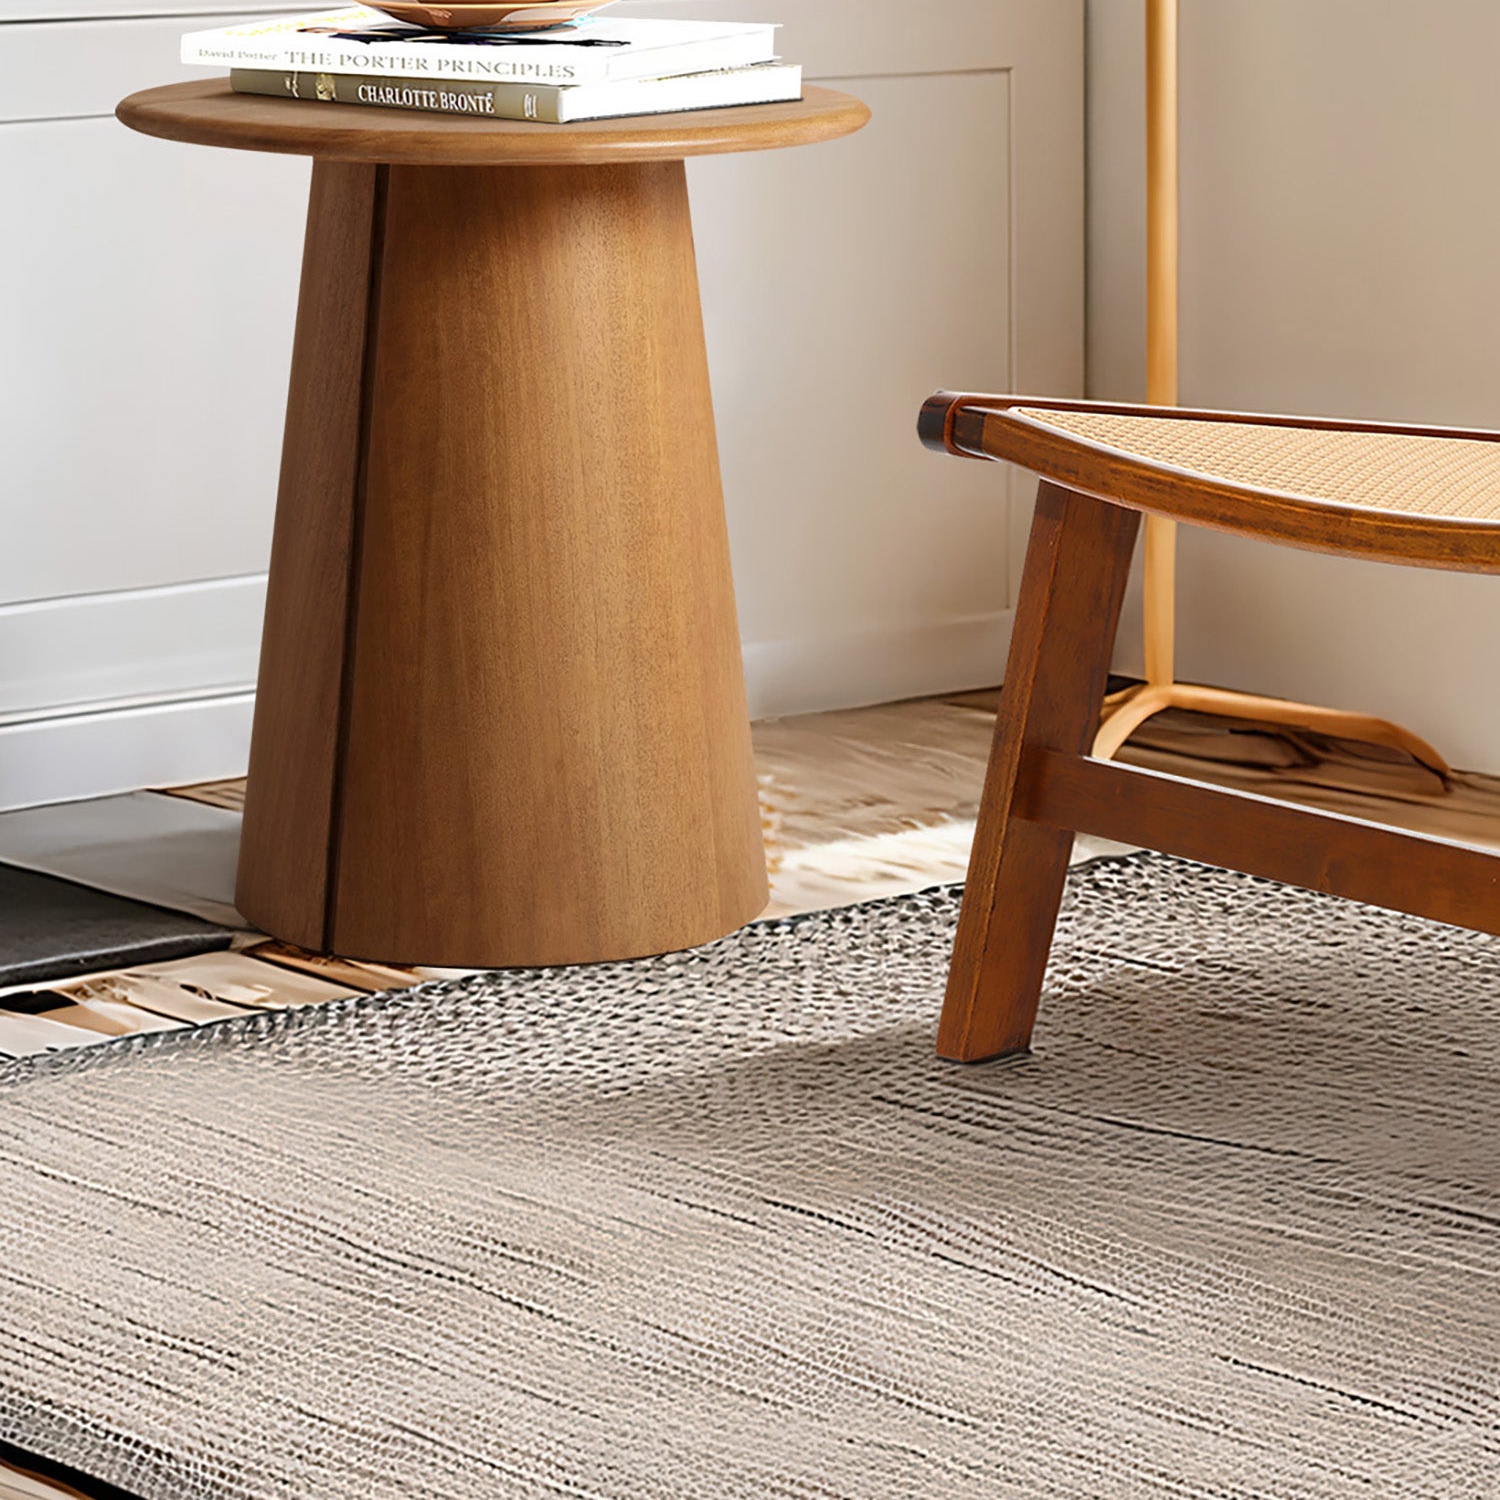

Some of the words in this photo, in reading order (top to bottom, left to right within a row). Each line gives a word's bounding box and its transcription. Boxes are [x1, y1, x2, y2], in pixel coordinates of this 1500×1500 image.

[198, 48, 235, 59] David
[285, 50, 332, 67] THE
[339, 53, 428, 71] PORTER
[437, 58, 576, 78] PRINCIPLES
[357, 83, 438, 109] CHARLOTTE
